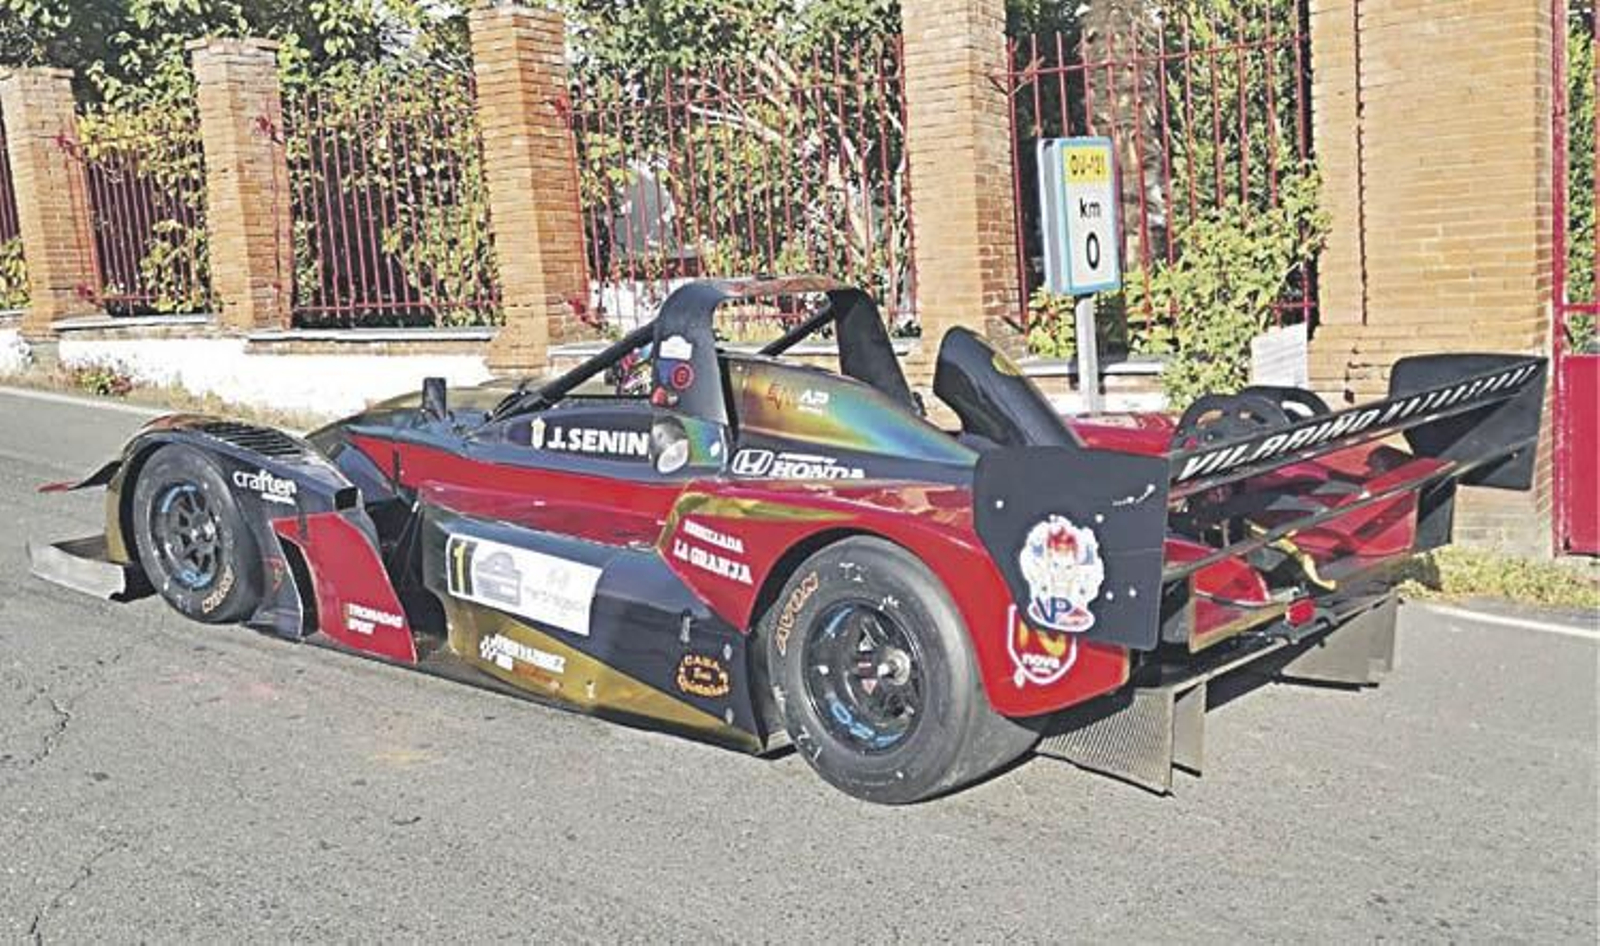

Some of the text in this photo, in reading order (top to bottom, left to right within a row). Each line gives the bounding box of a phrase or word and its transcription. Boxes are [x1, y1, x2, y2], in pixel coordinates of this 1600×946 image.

[1079, 197, 1101, 219] km
[1086, 231, 1100, 270] 0
[768, 460, 865, 479] HONDA
[453, 541, 467, 593] 1
[673, 538, 754, 585] LA GRANJA
[775, 570, 819, 656] AVON
